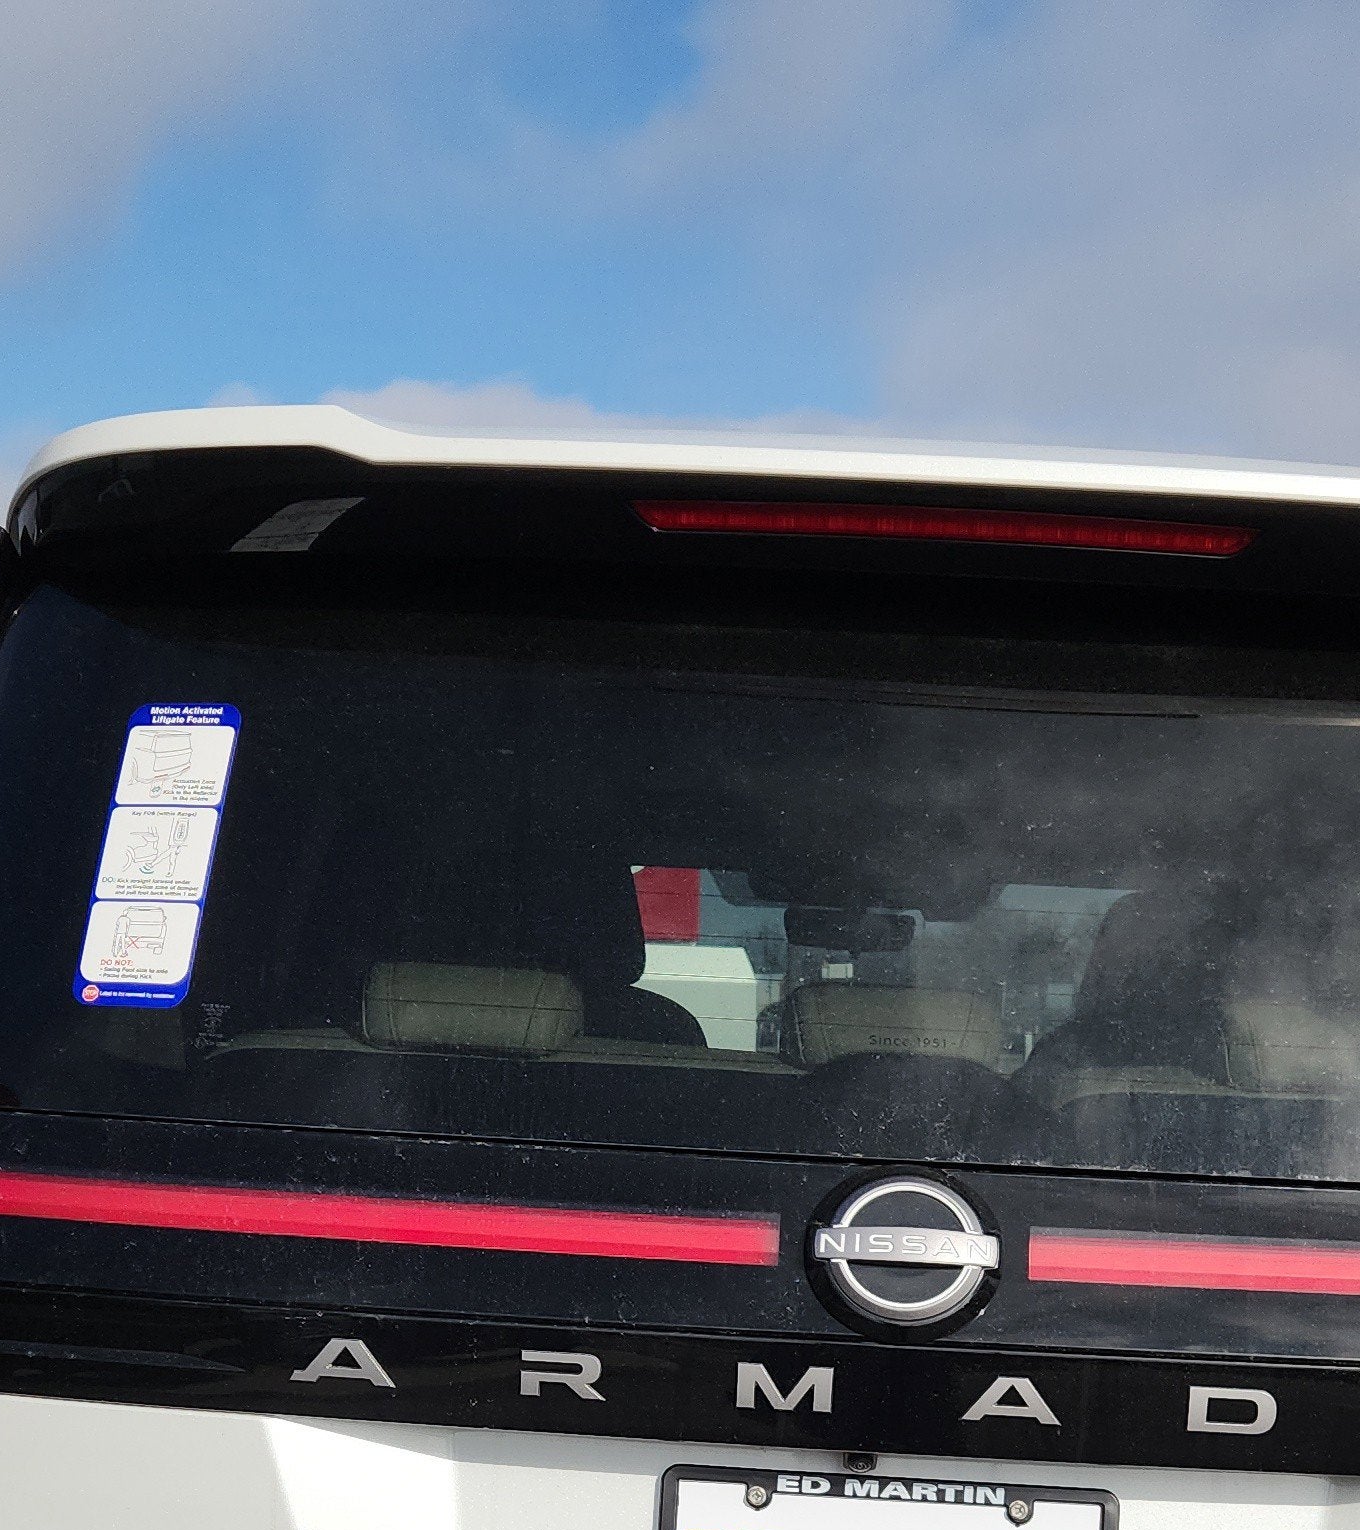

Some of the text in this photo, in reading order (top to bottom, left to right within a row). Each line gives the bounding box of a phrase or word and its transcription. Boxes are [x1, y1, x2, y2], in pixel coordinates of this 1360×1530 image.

[150, 706, 223, 715] Motion Activated
[152, 715, 220, 724] Liftgate Feature
[868, 1034, 910, 1047] Since
[819, 1233, 992, 1261] NISSAN
[776, 1475, 1007, 1507] ED MARTIN
